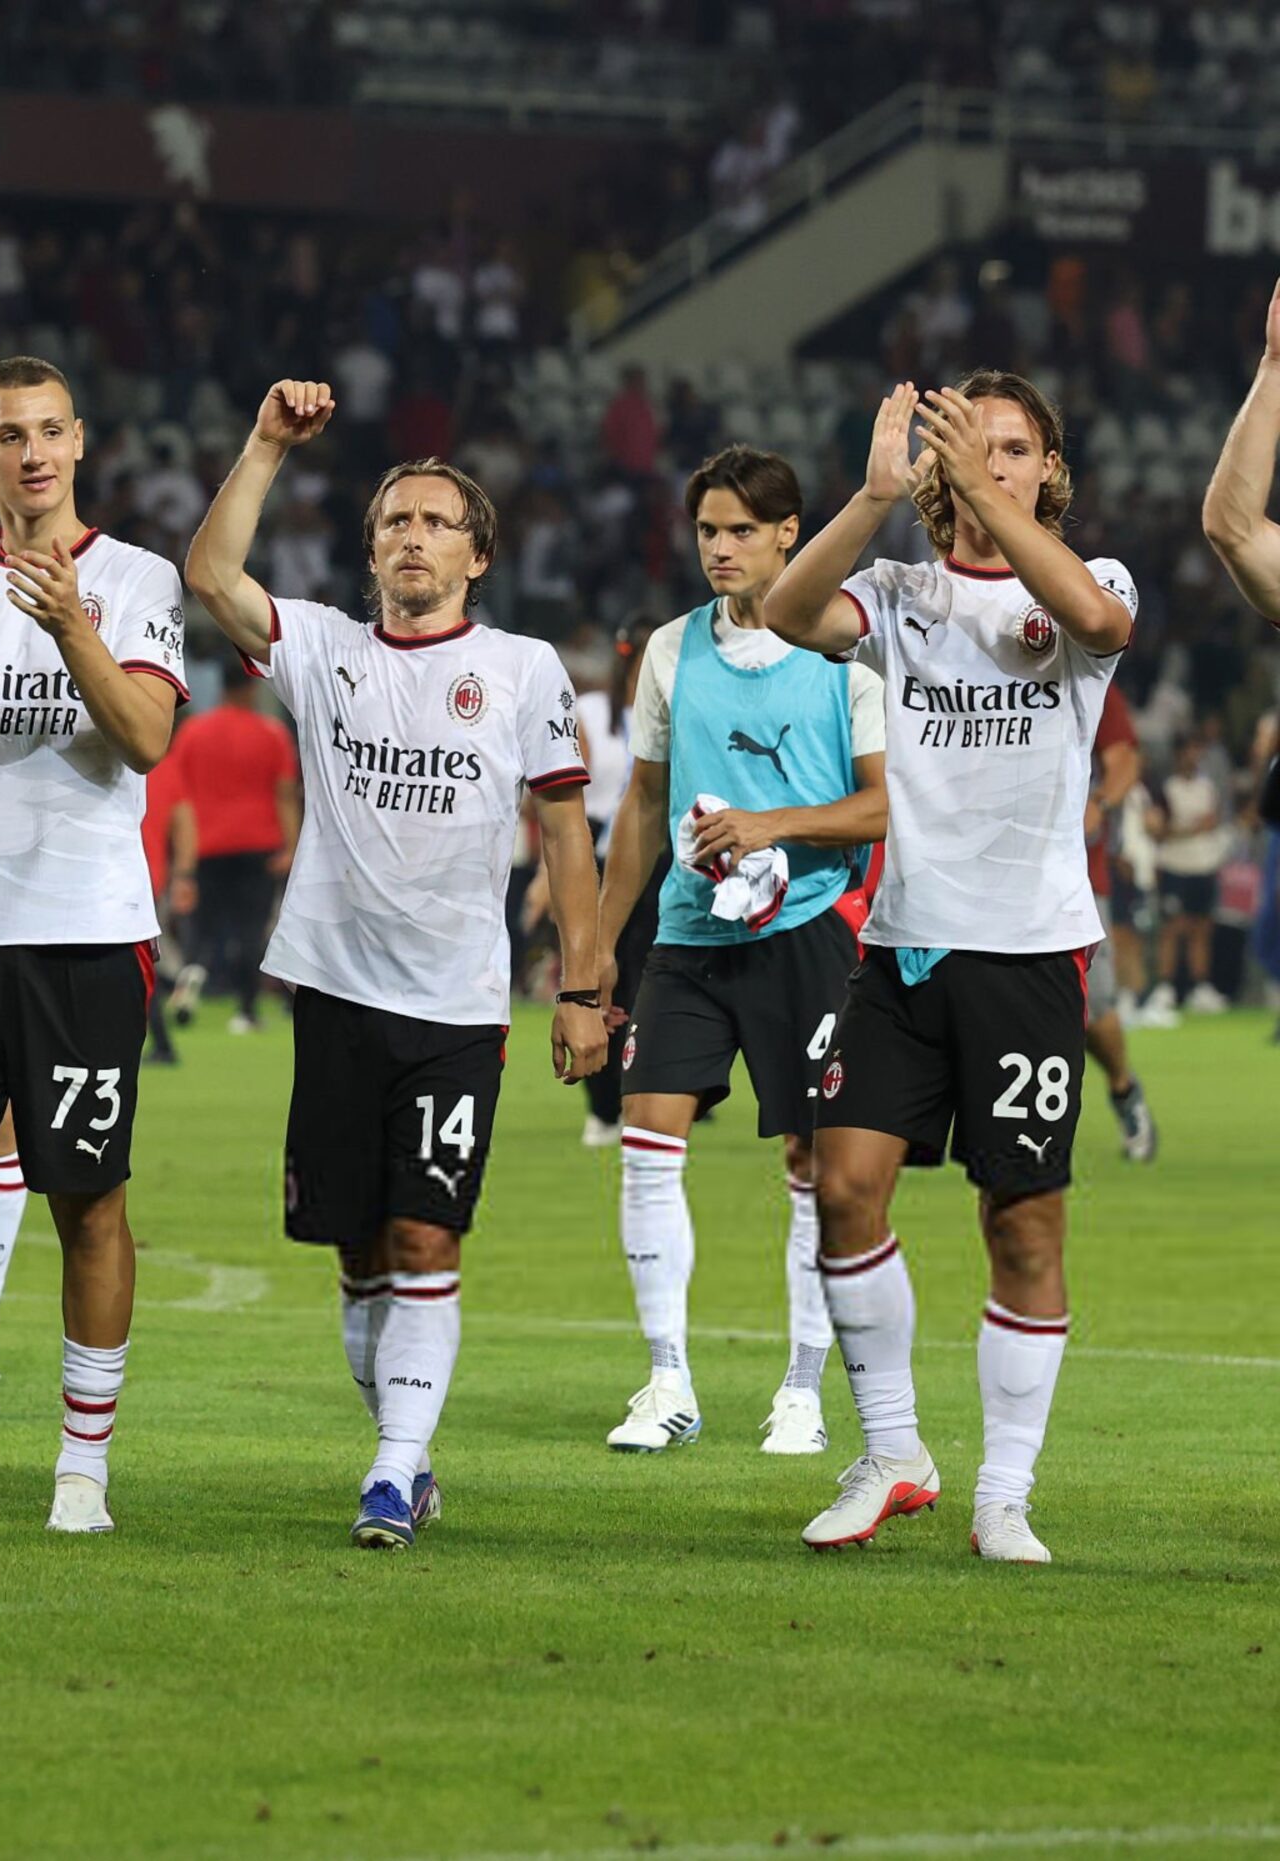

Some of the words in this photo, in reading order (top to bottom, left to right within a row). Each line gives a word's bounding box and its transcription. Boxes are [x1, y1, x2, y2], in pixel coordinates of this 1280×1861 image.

[902, 675, 1060, 713] Emirates
[0, 706, 78, 736] BETTER
[919, 719, 956, 747] FLY
[961, 716, 1032, 748] BETTER
[376, 780, 456, 815] BETTER
[50, 1065, 121, 1131] 73
[992, 1052, 1070, 1122] 28
[416, 1094, 476, 1160] 14
